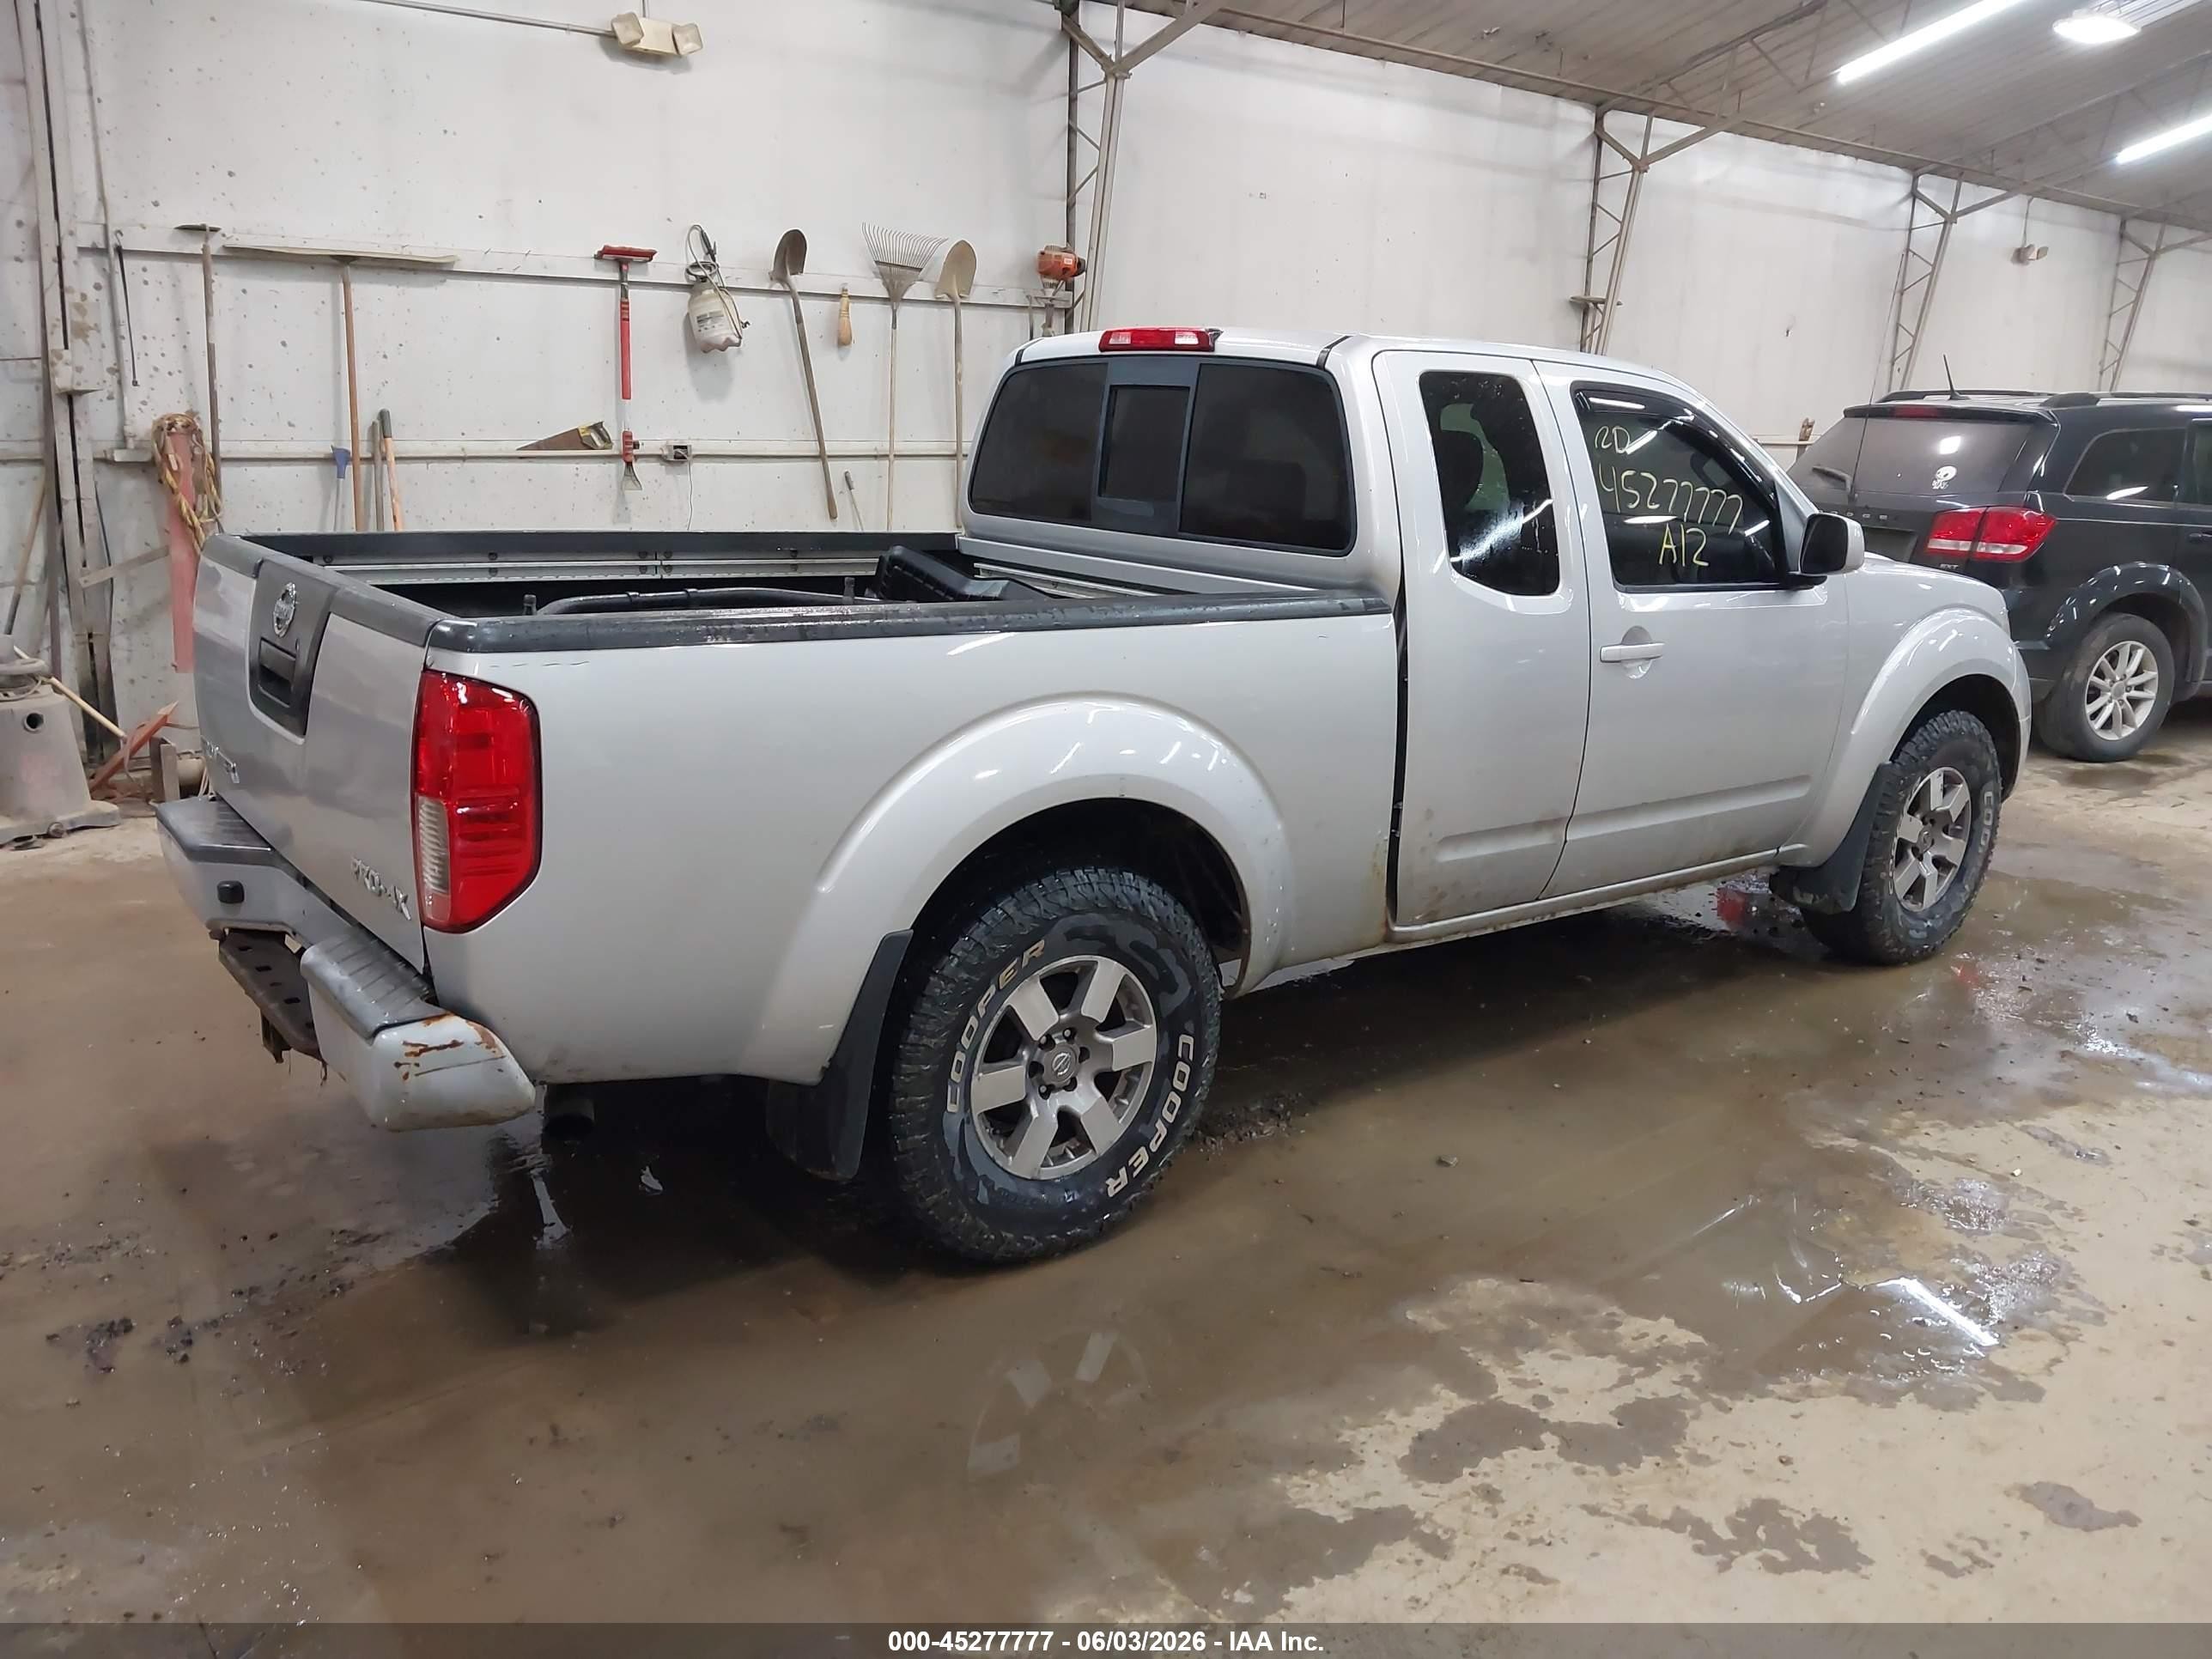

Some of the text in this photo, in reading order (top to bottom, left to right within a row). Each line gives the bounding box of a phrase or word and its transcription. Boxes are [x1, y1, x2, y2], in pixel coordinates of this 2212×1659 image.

[1598, 466, 1743, 536] 45277777
[1658, 523, 1709, 568] A12
[946, 939, 1045, 1113] COOPER
[1105, 1034, 1194, 1198] COOPER
